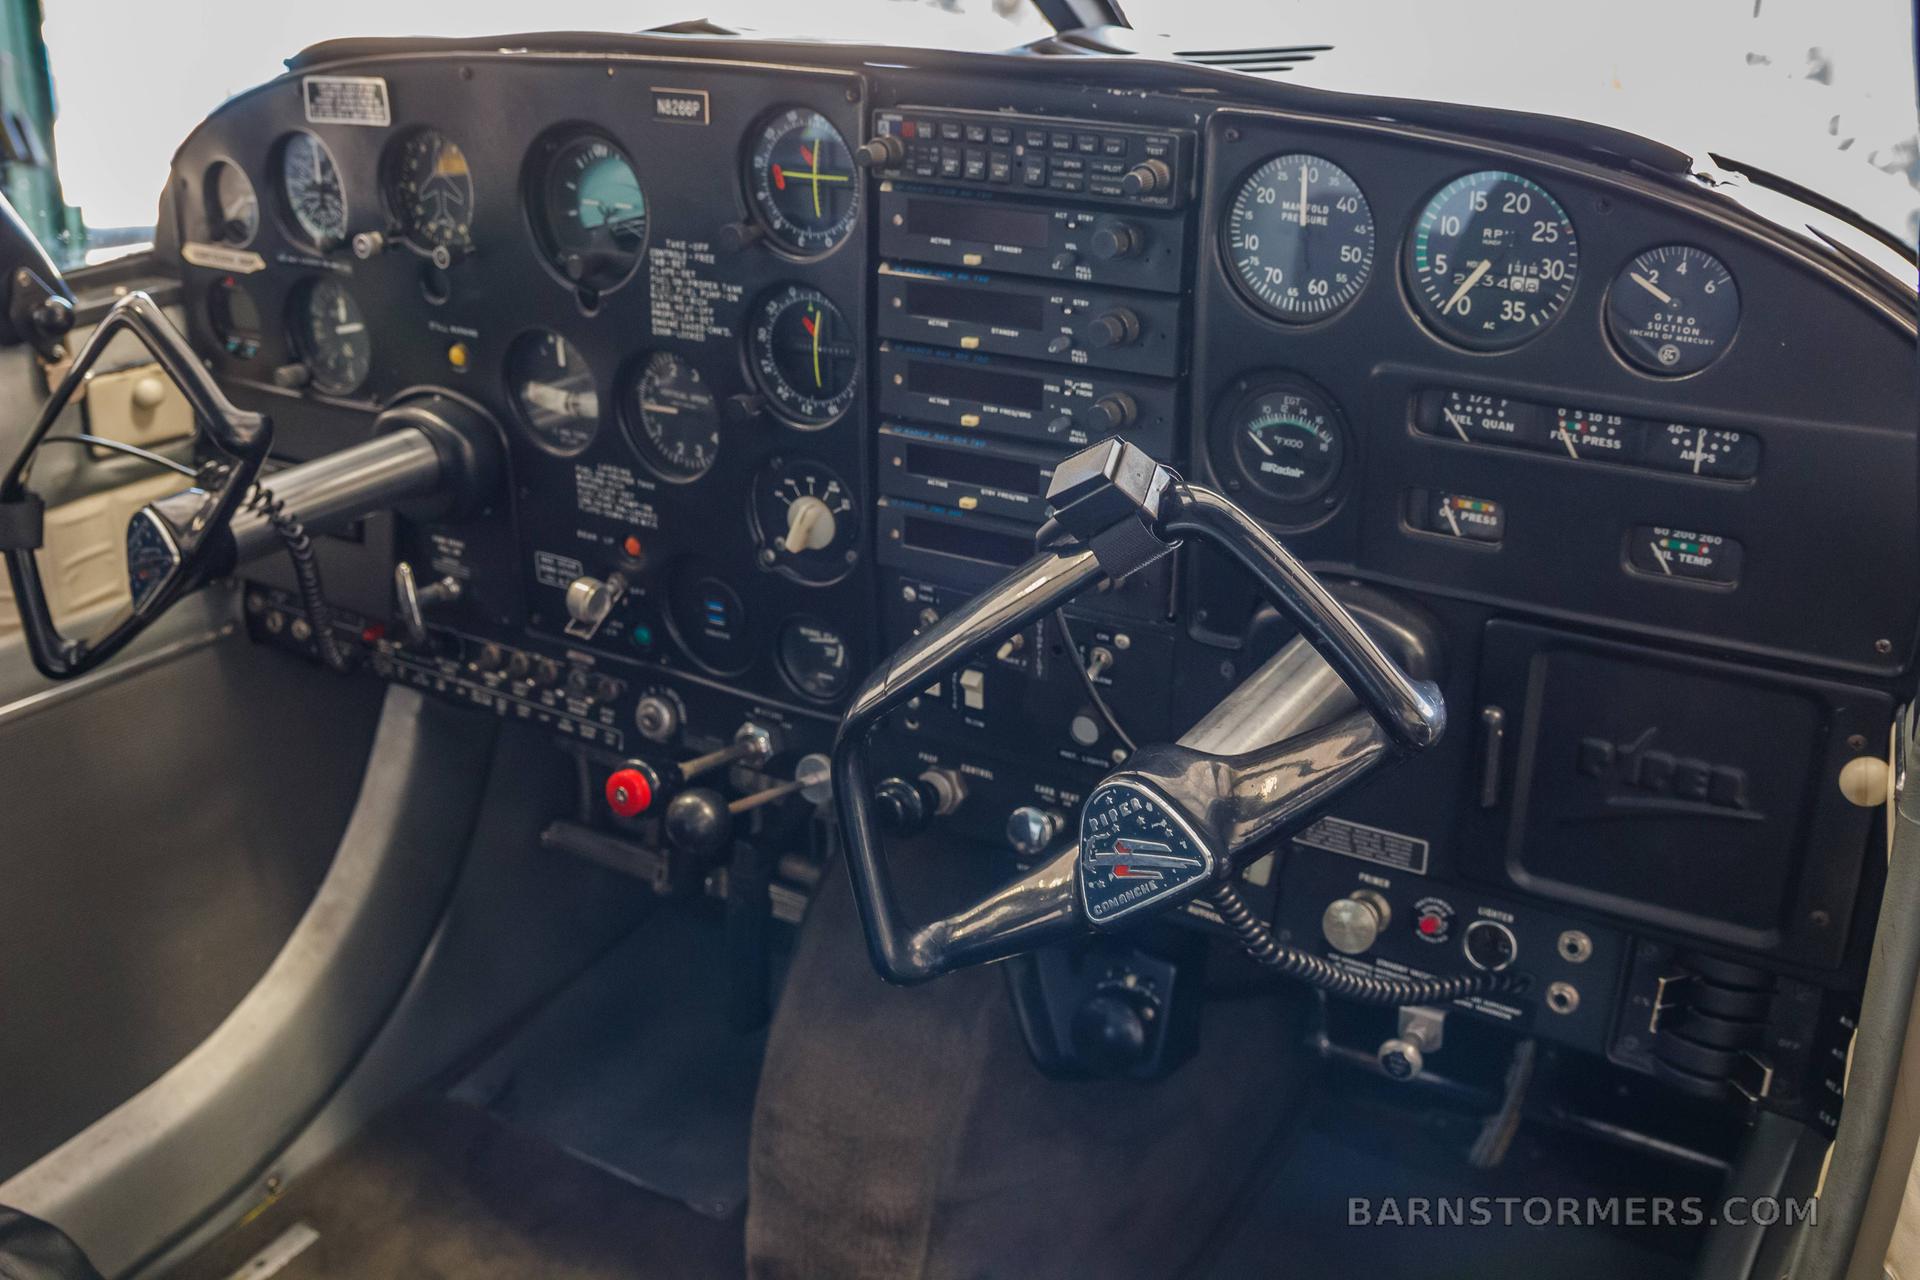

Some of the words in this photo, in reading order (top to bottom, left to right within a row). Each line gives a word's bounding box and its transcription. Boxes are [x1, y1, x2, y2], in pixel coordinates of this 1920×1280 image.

[1256, 187, 1276, 204] 20
[1469, 191, 1488, 212] 15
[1503, 192, 1531, 214] 20
[1282, 201, 1329, 215] MANFOLD
[1336, 197, 1358, 214] 40
[1281, 212, 1328, 226] PRESURE
[1441, 216, 1460, 237] 10
[1354, 225, 1366, 235] 45
[1531, 221, 1558, 243] 25
[1244, 235, 1259, 251] 10
[1340, 245, 1362, 263] 50
[1435, 254, 1447, 275] 5
[1539, 258, 1564, 281] 30
[1676, 261, 1688, 275] 4
[1264, 267, 1283, 284] 70
[1336, 273, 1348, 283] 55
[1649, 269, 1659, 284] 2
[1287, 287, 1298, 297] 65
[1308, 279, 1328, 296] 60
[1704, 280, 1716, 294] 6
[1457, 295, 1471, 316] 0
[1500, 300, 1526, 322] 35
[1482, 321, 1495, 330] AC
[1654, 312, 1696, 326] GYRO
[1629, 329, 1659, 339] INCHES
[1675, 335, 1715, 345] MERCURY
[1647, 322, 1700, 336] SUCTION
[1558, 408, 1566, 416] 0
[1575, 410, 1583, 419] 5
[1588, 413, 1603, 422] 10
[1607, 415, 1621, 425] 15
[1482, 418, 1514, 432] QUAN
[1699, 428, 1708, 437] 0
[1582, 435, 1622, 449] PRESS
[1460, 510, 1497, 526] PRESS
[1679, 552, 1712, 567] TEMP
[960, 764, 994, 781] CONTROL
[1093, 880, 1158, 916] COMANCHE
